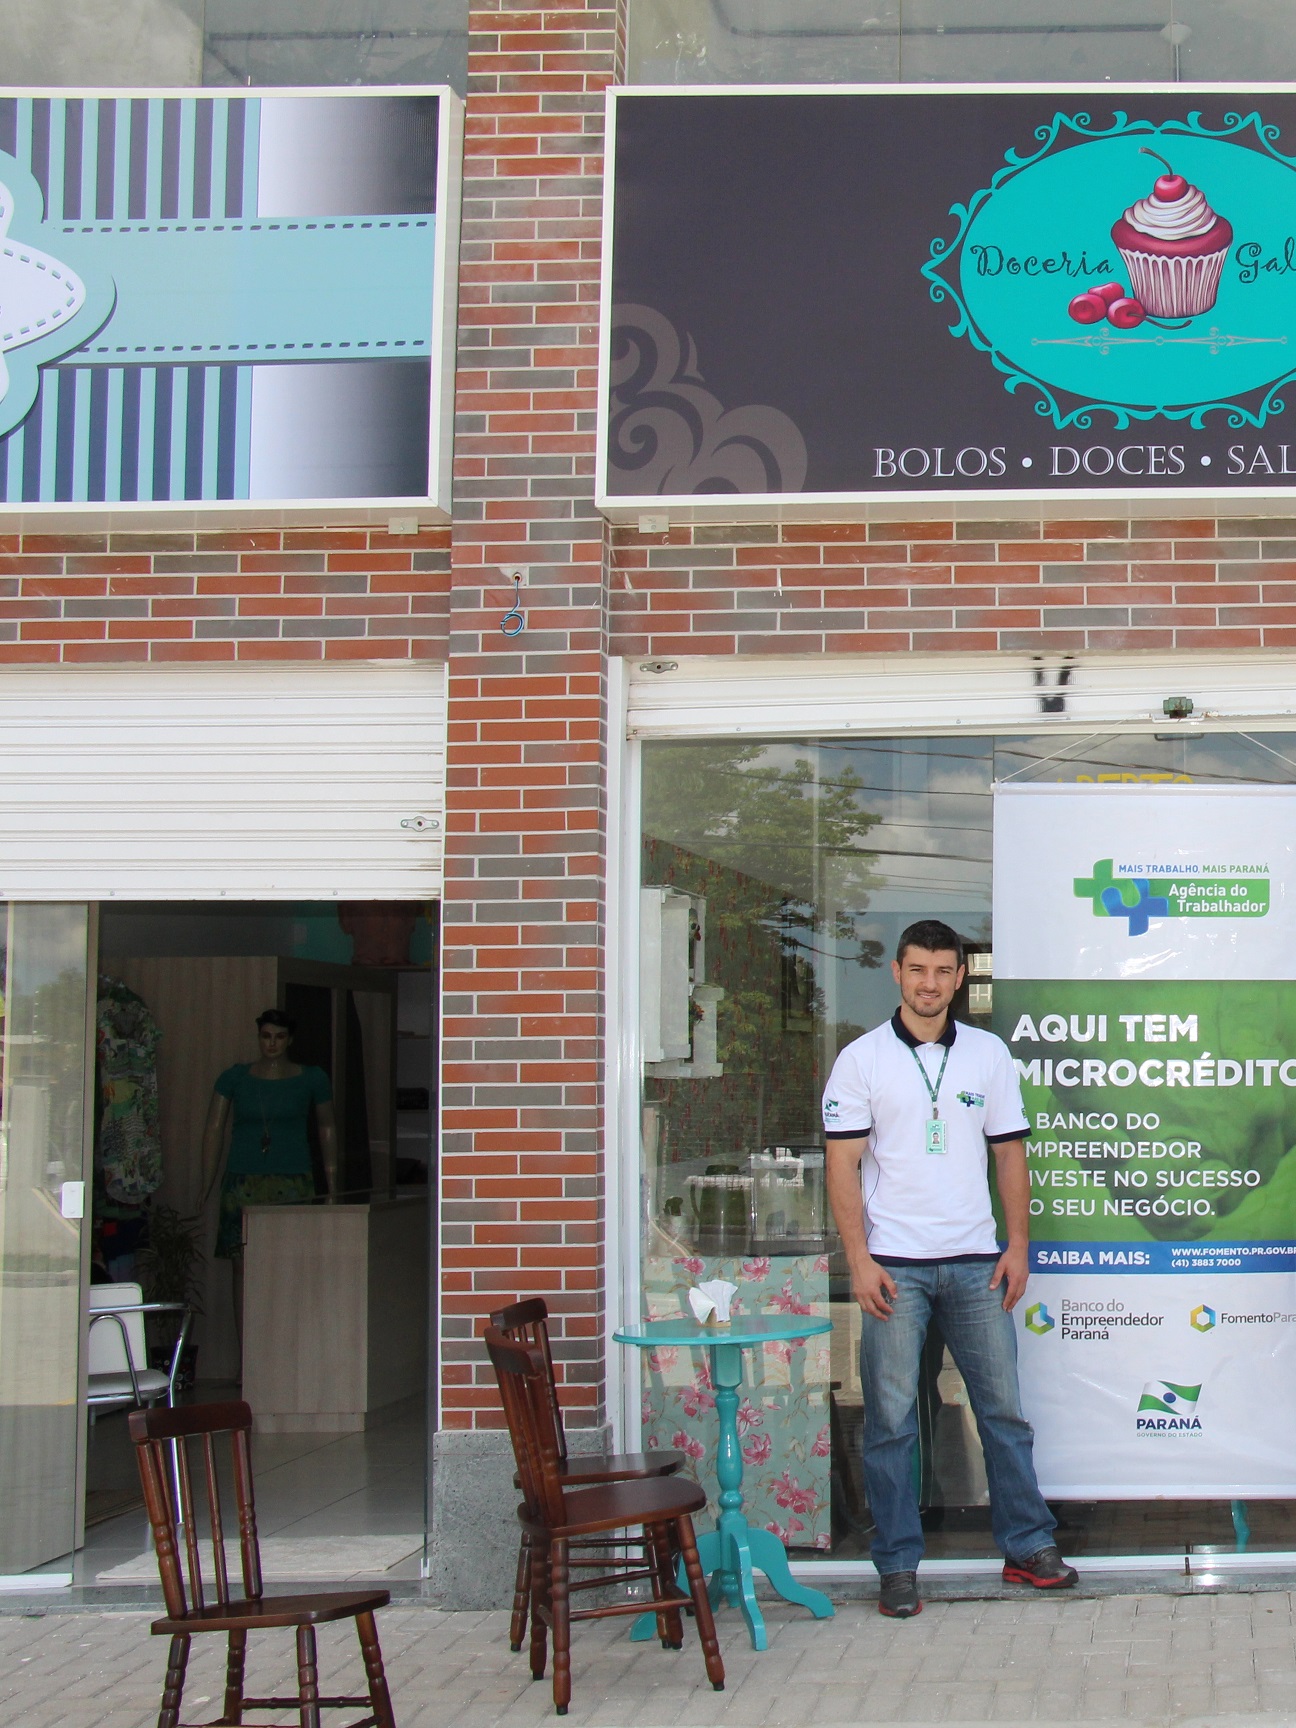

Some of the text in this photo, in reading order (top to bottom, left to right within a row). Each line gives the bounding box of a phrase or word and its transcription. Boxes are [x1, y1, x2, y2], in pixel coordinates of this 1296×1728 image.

[970, 244, 1115, 277] Doceria
[872, 446, 1006, 478] BOLOS
[1048, 444, 1186, 477] DOCES
[1118, 862, 1270, 874] MAIS TRABALHO, MAIS PARANÁ
[1168, 882, 1248, 899] Agência do
[1176, 899, 1267, 913] Trabalhador
[1010, 1013, 1199, 1043] AQUI TEM
[1036, 1112, 1160, 1130] BANCO DO
[1023, 1141, 1202, 1159] MPREENDEDOR
[1029, 1169, 1261, 1187] VESTE NO SUCESSO
[1029, 1195, 1216, 1217] O SEU NEGÓCIO.
[1037, 1250, 1150, 1266] SAIBA MAIS:
[1171, 1258, 1241, 1268] (41) 3883 7000
[1061, 1299, 1124, 1313] Banco do
[1061, 1313, 1164, 1331] Empreendedor
[1061, 1325, 1109, 1340] Paraná
[1136, 1415, 1202, 1430] PARANÁ
